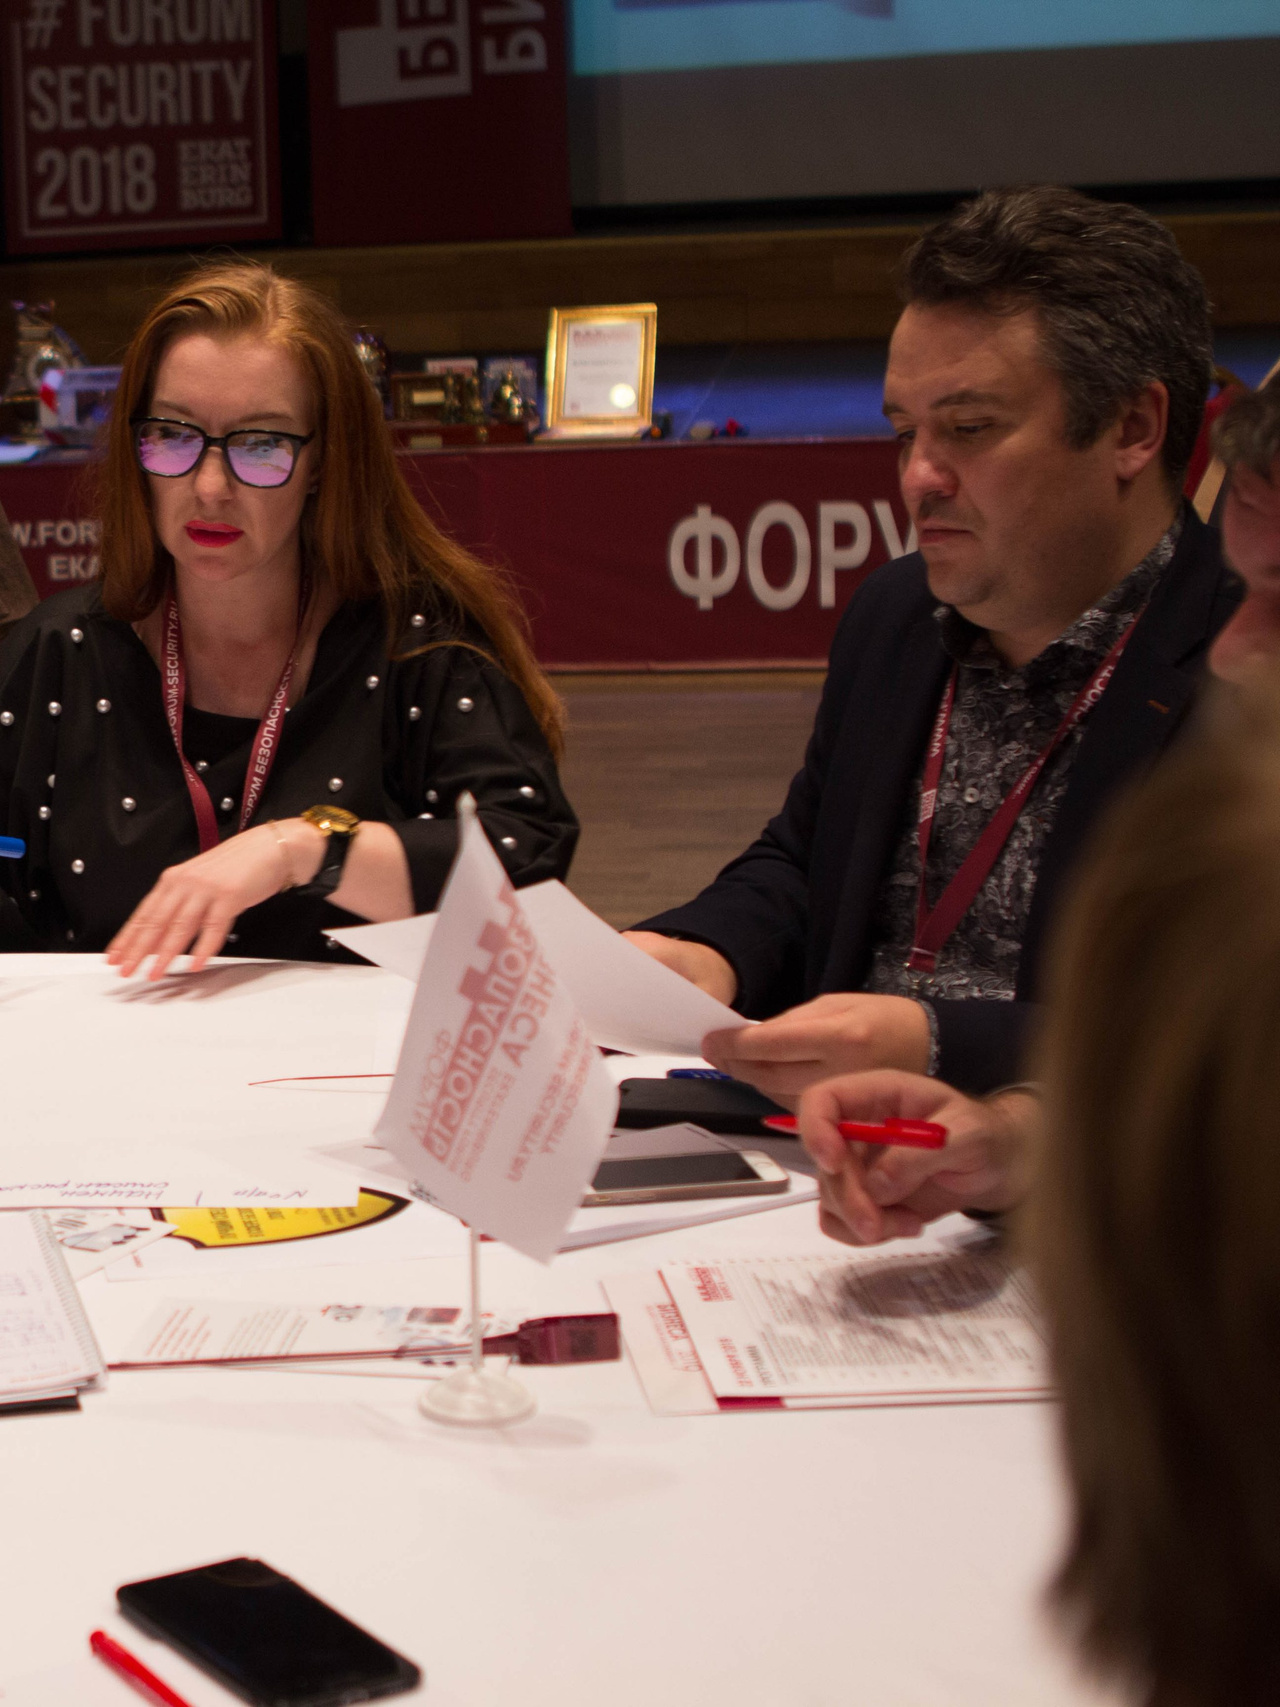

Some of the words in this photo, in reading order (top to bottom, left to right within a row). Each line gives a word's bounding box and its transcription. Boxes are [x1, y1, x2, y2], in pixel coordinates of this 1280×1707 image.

[75, 0, 252, 48] FORUM
[27, 59, 252, 133] SECURITY
[33, 141, 158, 220] 2018
[253, 666, 293, 774] БЕЗОПАСНОСТЬ
